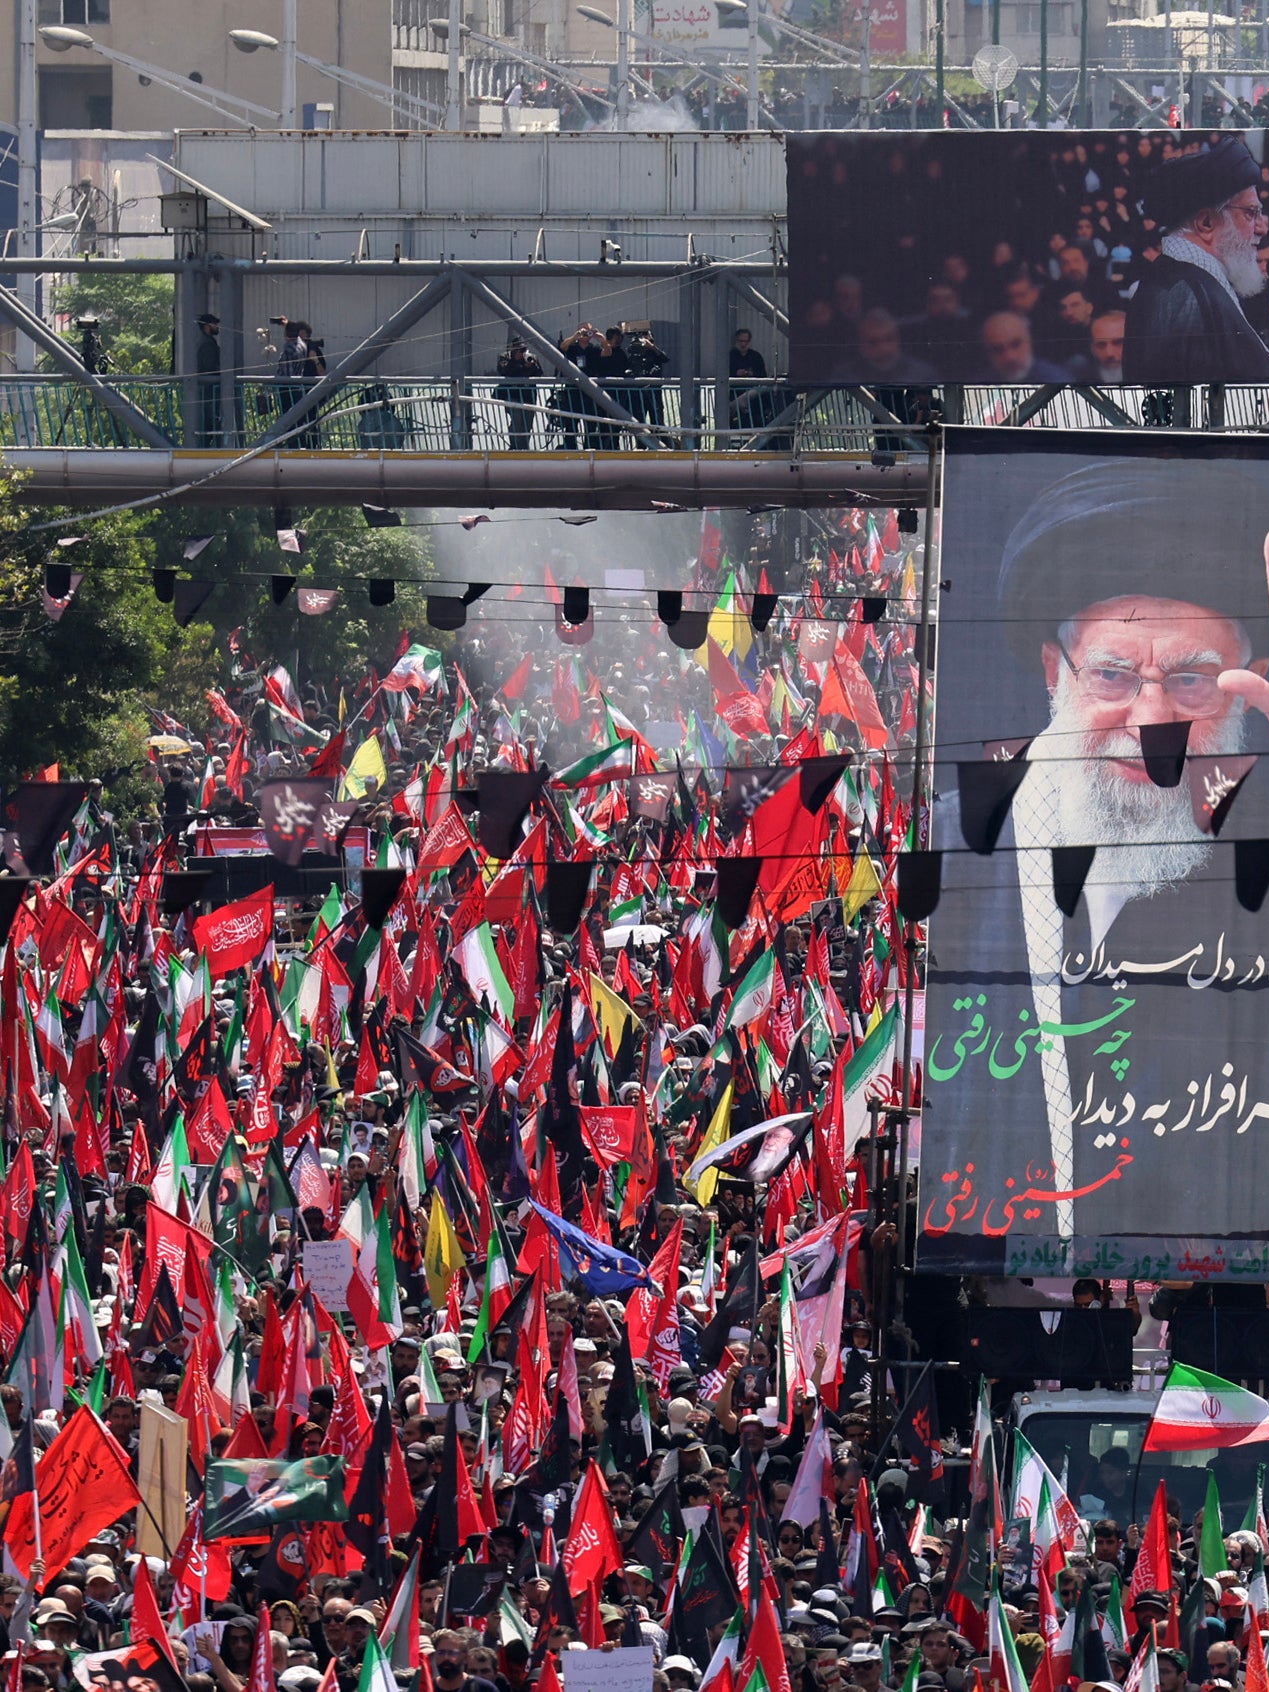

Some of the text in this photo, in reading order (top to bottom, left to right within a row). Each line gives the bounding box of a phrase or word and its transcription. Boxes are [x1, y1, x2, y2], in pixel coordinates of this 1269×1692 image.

[654, 5, 711, 26] شهادت
[1060, 940, 1205, 991] میدان
[1186, 932, 1236, 990] دل
[1238, 954, 1265, 985] در
[928, 993, 992, 1082] رفتی
[988, 995, 1136, 1080] حسینی
[1093, 1028, 1133, 1081] چه
[1068, 1071, 1136, 1149] دیدار
[1140, 1099, 1171, 1137] به
[923, 1162, 980, 1240] رفتی
[982, 1136, 1135, 1239] خمینی
[1007, 1239, 1027, 1276] نو
[1032, 1237, 1072, 1276] آباد
[1073, 1241, 1124, 1277] خانی
[1177, 1245, 1226, 1279] شهید
[1227, 1243, 1269, 1275] امت
